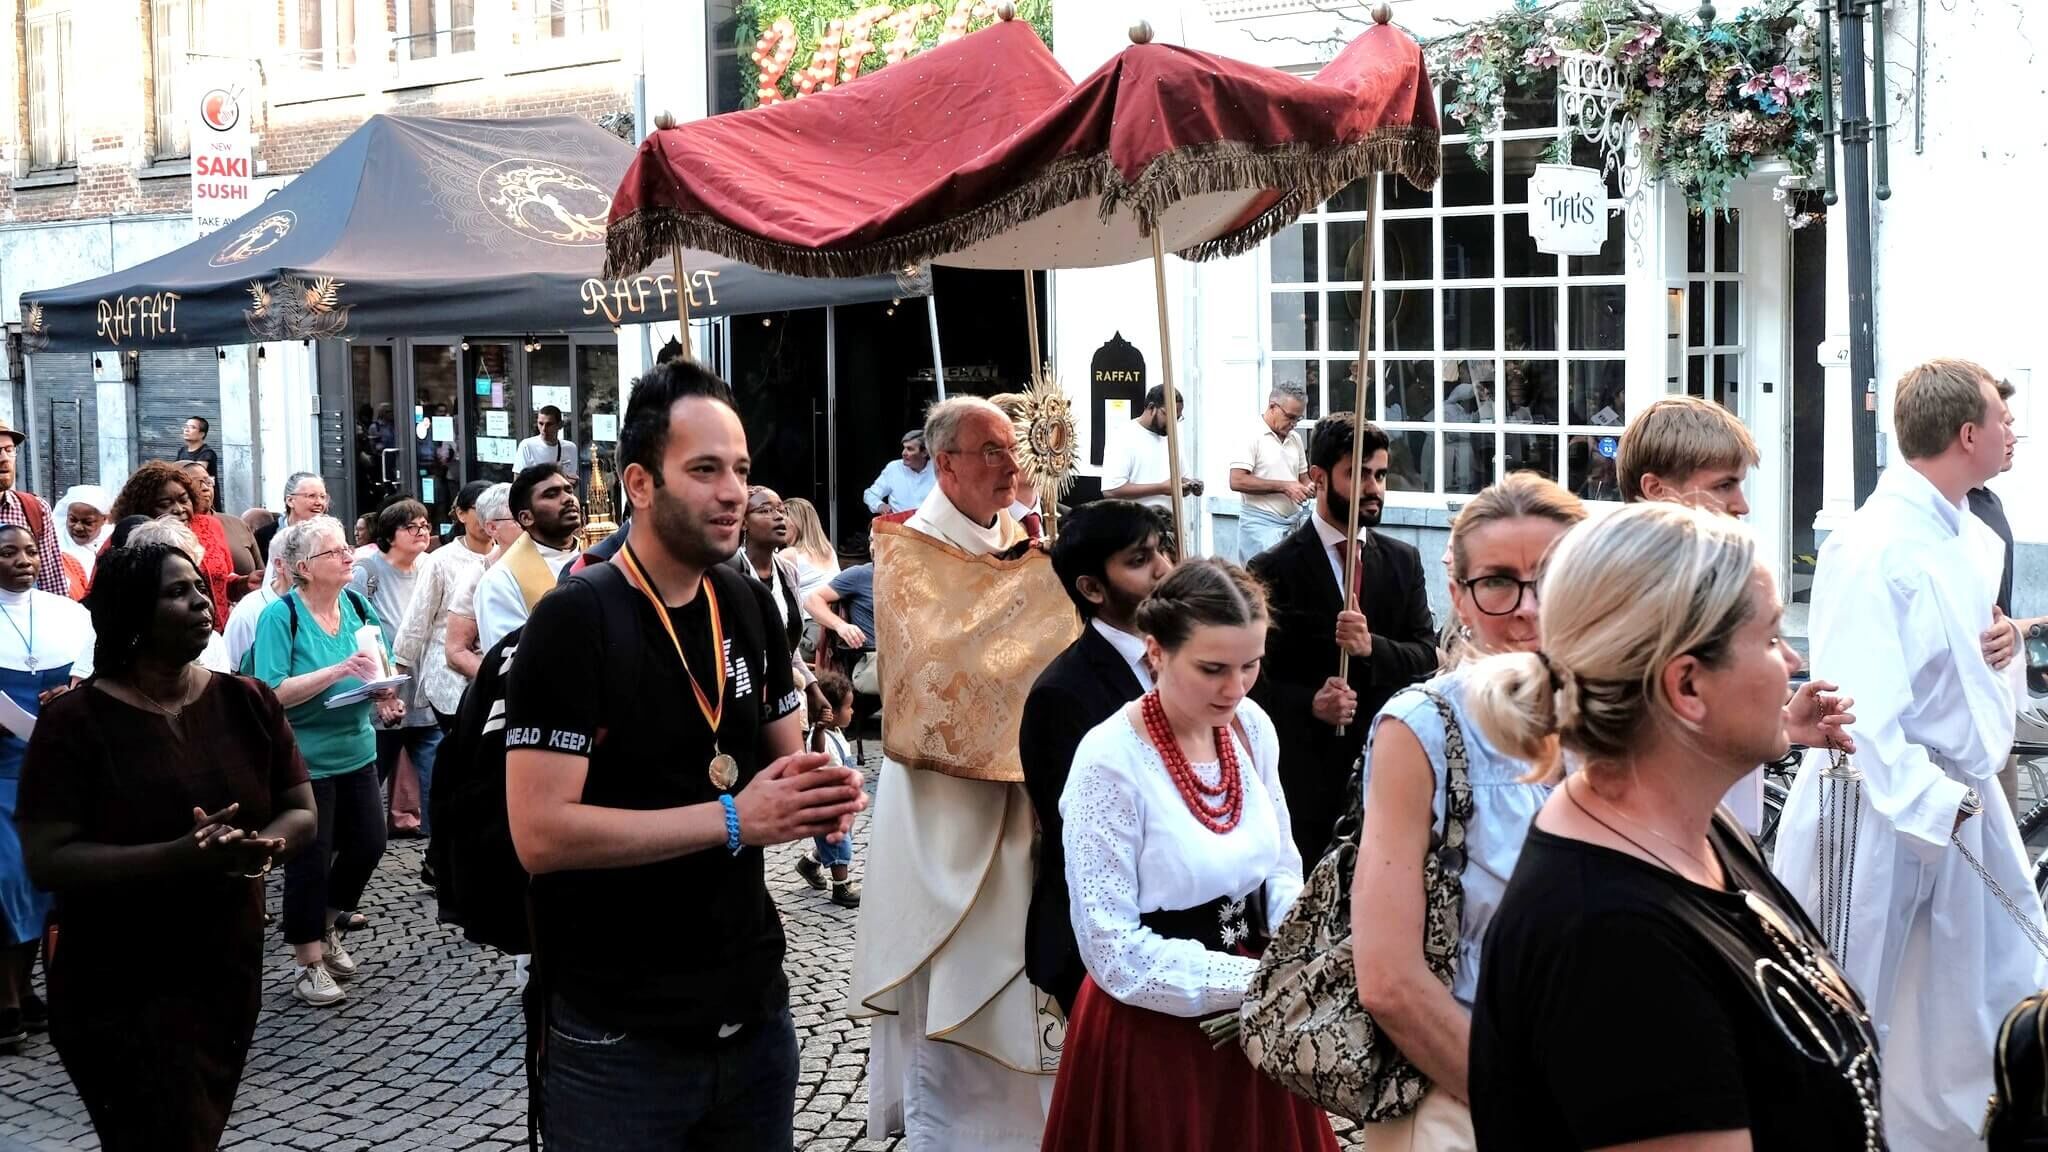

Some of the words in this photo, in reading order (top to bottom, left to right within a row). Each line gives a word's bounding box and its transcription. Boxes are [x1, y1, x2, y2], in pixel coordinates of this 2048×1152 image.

[210, 143, 232, 151] NEW
[196, 155, 247, 177] SAKI
[197, 184, 248, 200] SUSHI
[197, 217, 219, 226] TAKE
[580, 270, 721, 323] RAFFAT
[97, 292, 181, 346] RAFFAT
[1837, 349, 1848, 360] 47
[1096, 371, 1140, 382] RAFFAT
[548, 729, 586, 752] KEEP
